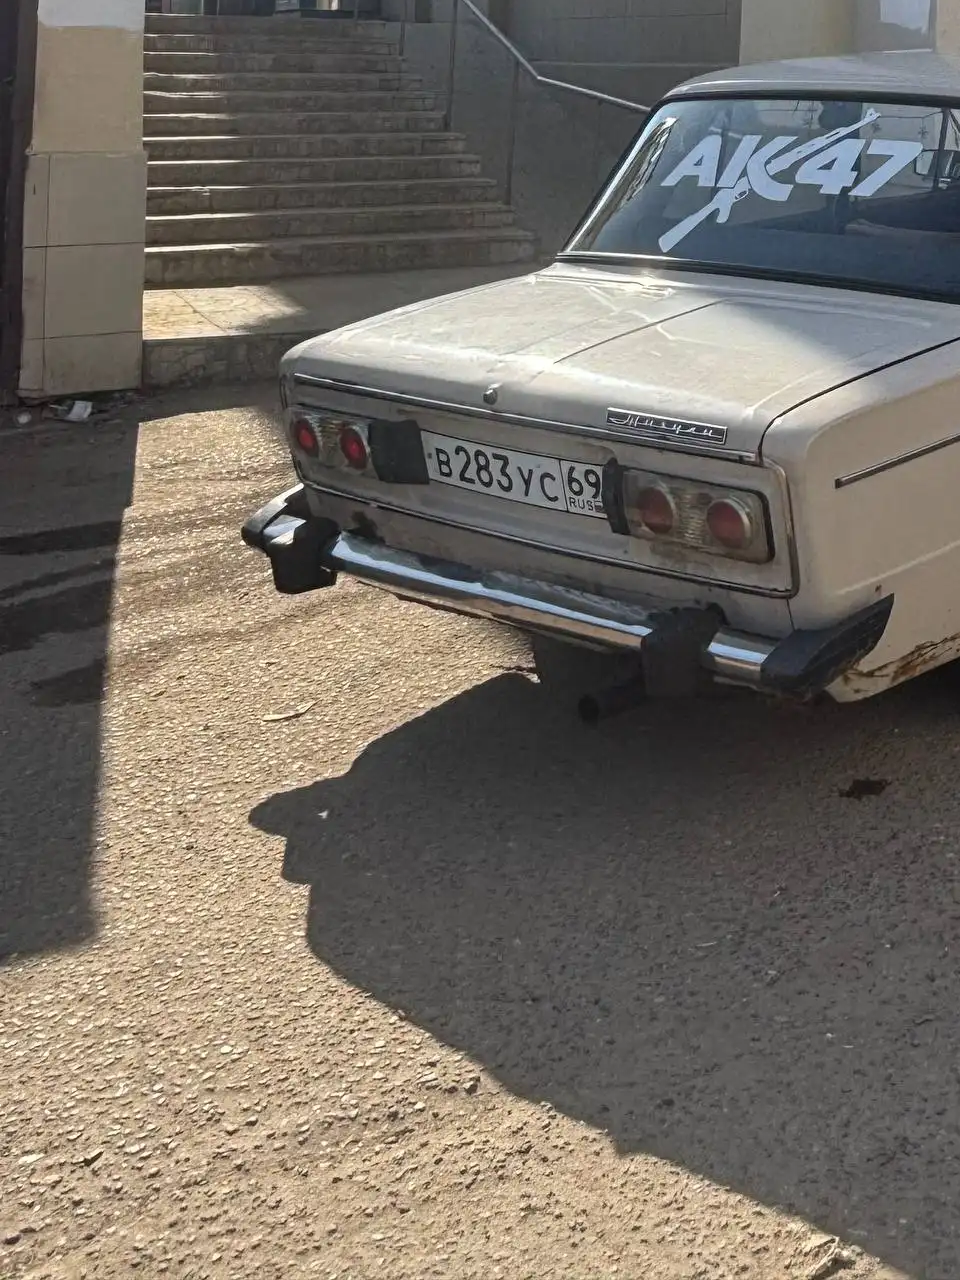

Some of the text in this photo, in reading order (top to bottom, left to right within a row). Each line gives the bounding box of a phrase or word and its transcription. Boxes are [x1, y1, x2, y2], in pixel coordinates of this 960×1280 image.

[435, 445, 601, 502] В283УС 69
[569, 497, 594, 511] RUS
